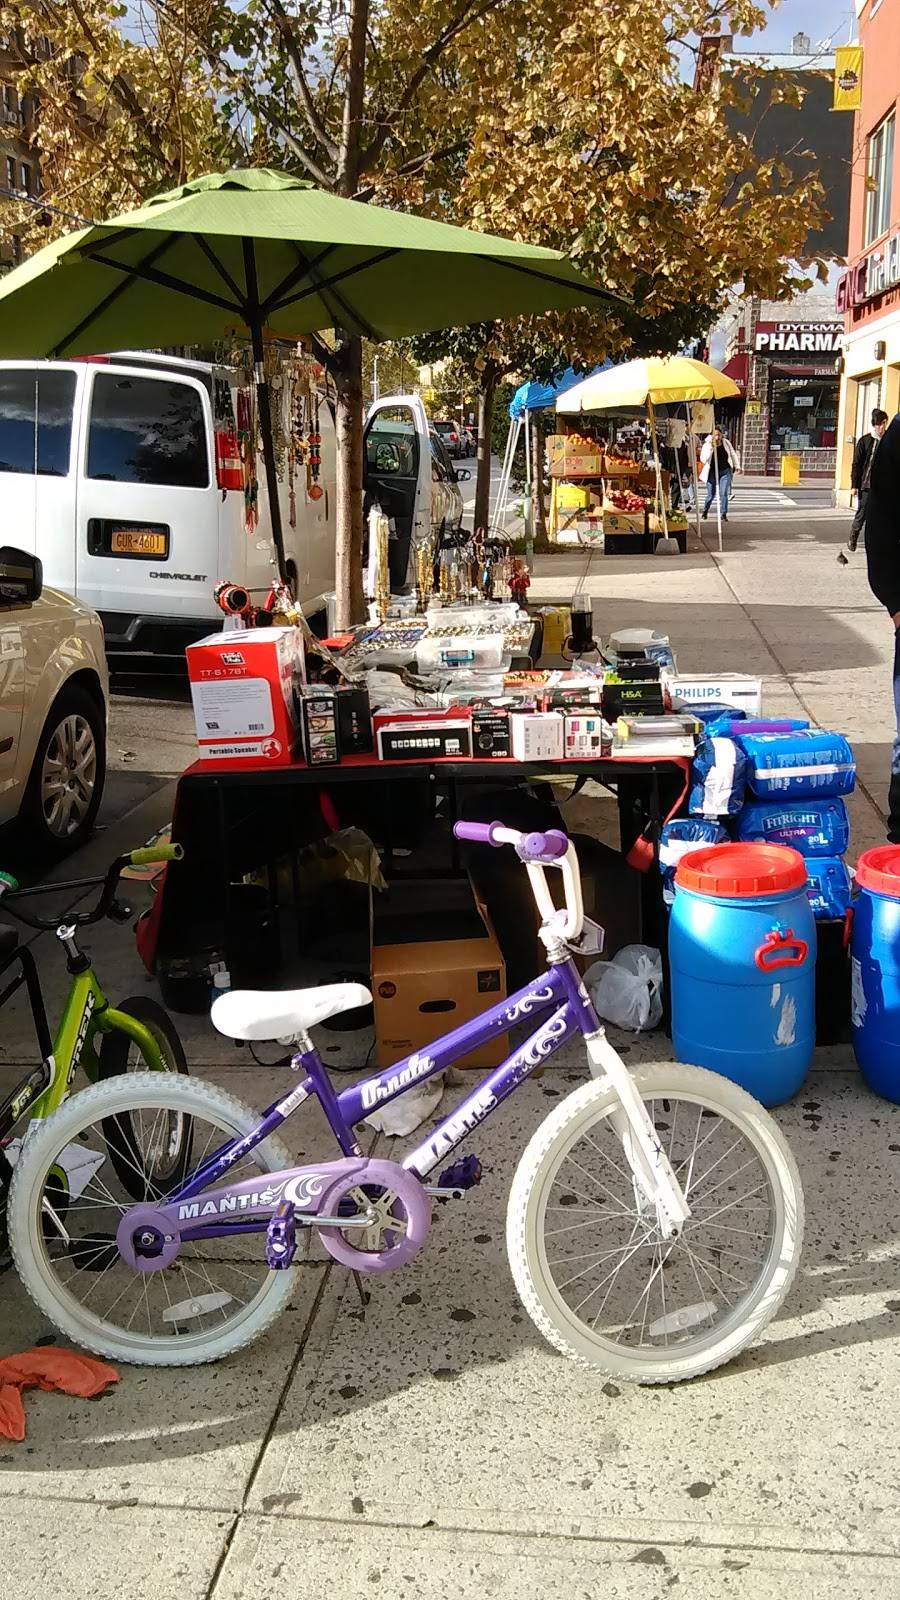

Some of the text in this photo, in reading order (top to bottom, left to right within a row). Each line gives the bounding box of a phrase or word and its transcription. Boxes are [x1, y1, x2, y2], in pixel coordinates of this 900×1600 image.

[835, 259, 866, 314] GNC
[149, 571, 208, 582] CHEVROLET
[675, 688, 722, 698] PHILIPS
[779, 829, 806, 837] ULTRA
[178, 1189, 276, 1220] MANTIS
